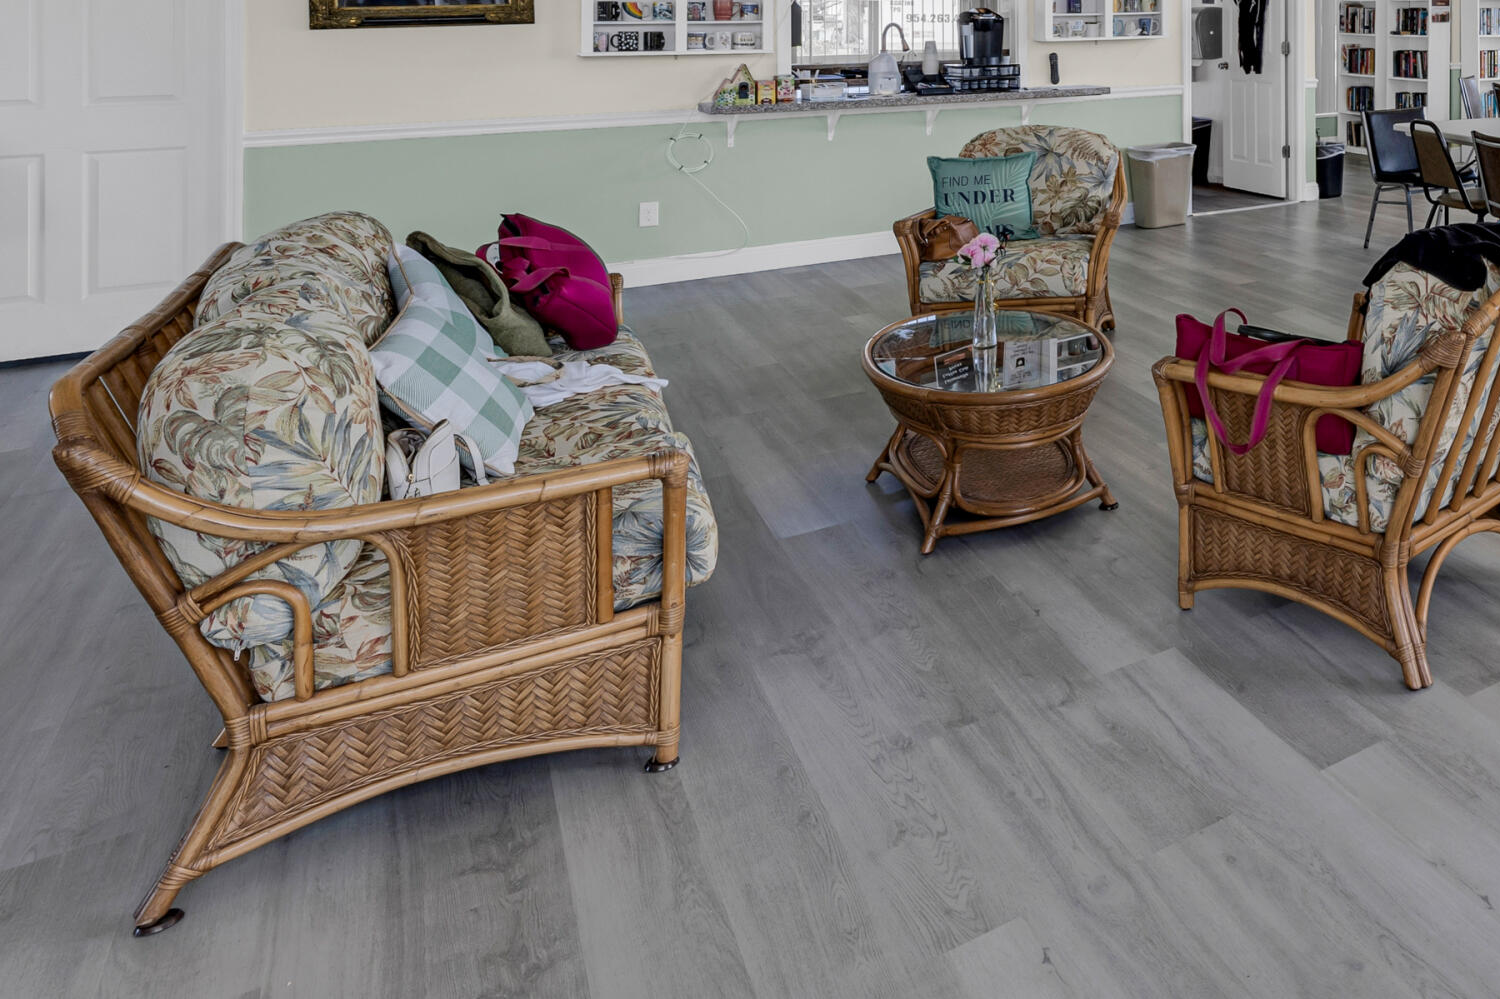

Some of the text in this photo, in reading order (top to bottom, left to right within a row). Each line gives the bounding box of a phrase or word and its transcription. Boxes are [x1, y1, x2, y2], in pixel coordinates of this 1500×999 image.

[941, 174, 991, 188] FIND ME
[943, 188, 1016, 208] UNDER
